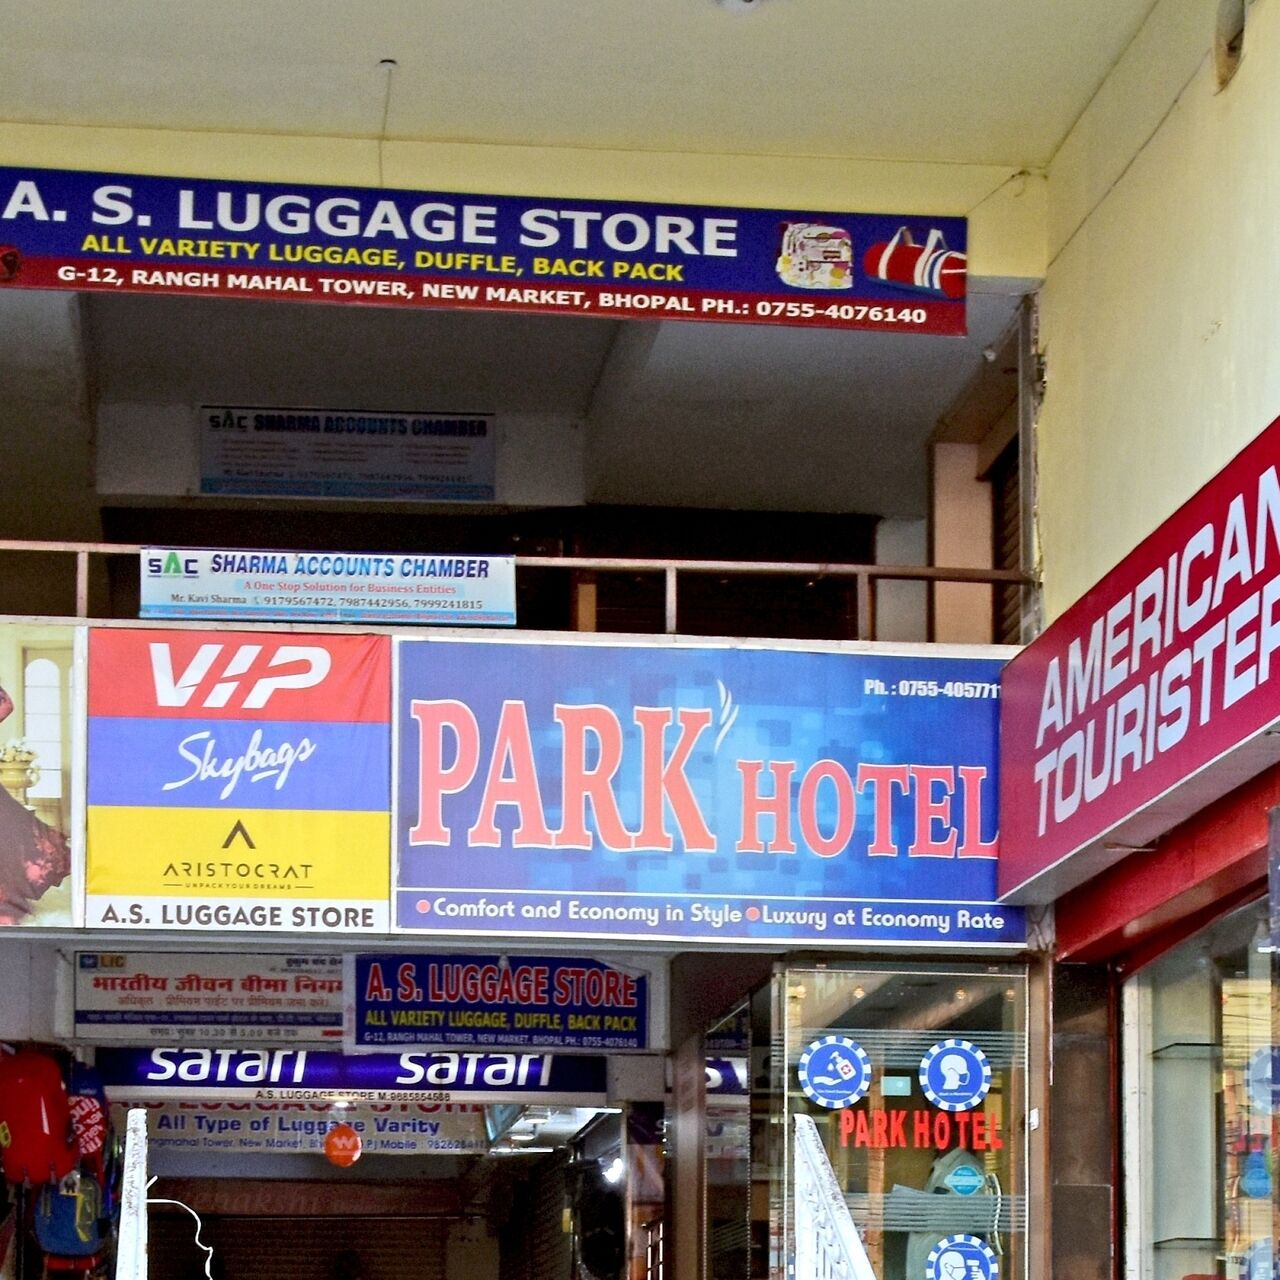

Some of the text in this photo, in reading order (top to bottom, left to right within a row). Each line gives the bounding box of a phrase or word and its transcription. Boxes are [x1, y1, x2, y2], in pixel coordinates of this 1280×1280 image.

[1, 180, 739, 258] A. S. LUGGAGE STORE
[81, 233, 685, 282] ALL VARIETY LUGGAGE, DUFFLE, BACK PACK
[57, 265, 124, 286] G-12,
[131, 270, 220, 288] RANGH
[227, 273, 313, 292] MAHAL
[318, 277, 415, 299] TOWER,
[422, 283, 479, 299] NEW
[485, 287, 592, 309] MARKET,
[598, 293, 695, 312] BHOPAL
[756, 301, 927, 324] 0755-4076140
[253, 413, 320, 434] SHARMA
[410, 418, 488, 438] CHAMBER
[210, 553, 289, 575] SHARMA
[293, 555, 395, 578] ACCOUNTS
[399, 557, 491, 580] CHAMBER
[211, 594, 247, 605] Sharma
[243, 581, 458, 596] A One Stop Solution for Business Entities
[147, 642, 333, 710] VIP
[160, 727, 318, 801] Skybags
[408, 699, 1001, 860] PARK HOTEL
[162, 861, 315, 880] ARISTOCRAT
[100, 903, 375, 928] A.S. LUGGAGE STORE
[432, 897, 1005, 933] Comfort and Economy in Style Luxury at Economy Rate
[92, 973, 169, 993] भारतीय
[175, 974, 235, 993] जीवन
[364, 962, 638, 1008] A. S. LUGGAGE STORE
[364, 1010, 638, 1033] ALL VARIETY LUGGAGE, DUFFLE, BACK PACK
[477, 1034, 497, 1044] NEW
[532, 1035, 564, 1046] BHOPAL
[255, 1090, 276, 1100] A.S.
[280, 1091, 338, 1100] LUGGAGE
[338, 1091, 375, 1101] STORE
[156, 1114, 186, 1130] All
[194, 1115, 242, 1134] Type
[249, 1116, 270, 1131] of
[373, 1116, 441, 1136] Varity
[839, 1109, 1005, 1151] PARK HOTEL
[239, 1138, 262, 1148] New
